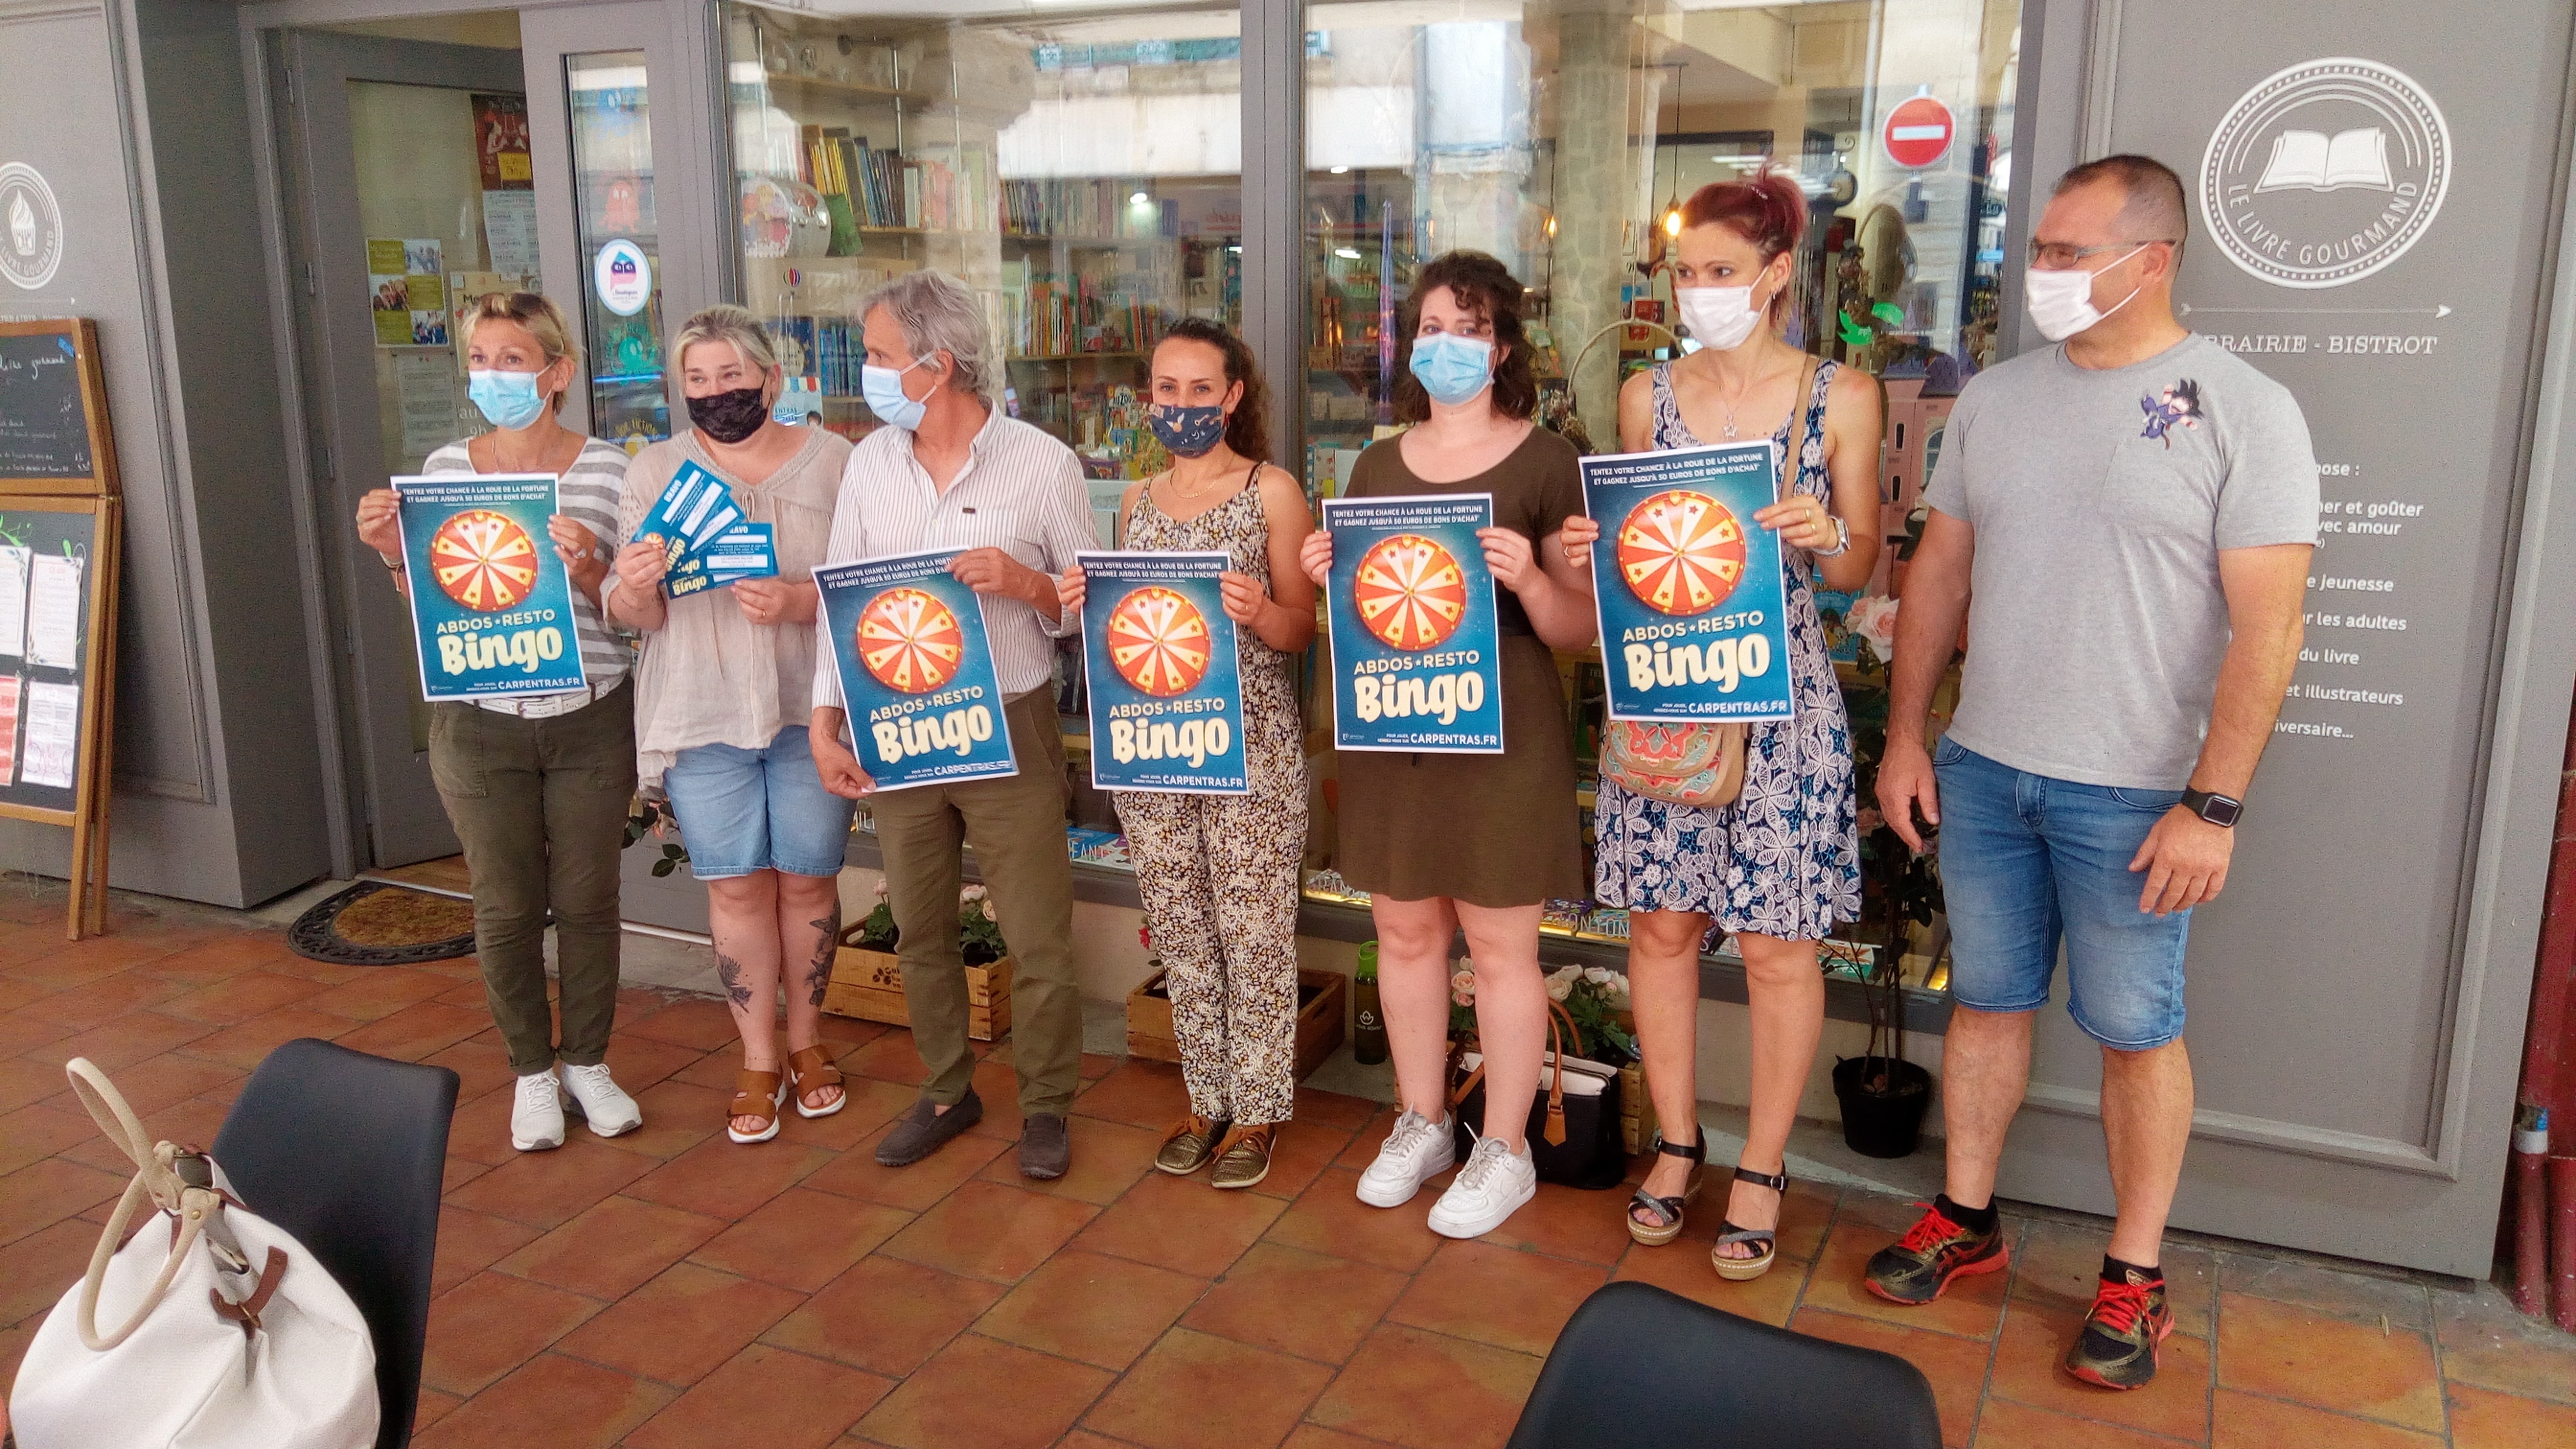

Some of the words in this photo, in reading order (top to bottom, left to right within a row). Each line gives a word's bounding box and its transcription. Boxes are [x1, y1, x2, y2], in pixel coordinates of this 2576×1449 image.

[2228, 184, 2250, 209] LE
[2299, 182, 2418, 265] GOURMAND
[2237, 211, 2291, 260] LIVRE
[2328, 335, 2439, 355] BISTROT
[1666, 461, 1672, 470] À
[1672, 462, 1682, 470] LA
[1706, 458, 1716, 466] DE
[1716, 457, 1728, 465] LA
[1594, 477, 1601, 486] ET
[1694, 470, 1704, 478] DE
[1401, 506, 1406, 516] À
[2345, 501, 2363, 515] et
[2367, 501, 2424, 519] goûter
[1335, 518, 1342, 526] ET
[1394, 517, 1401, 525] 50
[1423, 516, 1432, 525] DE
[2318, 521, 2342, 533] vec
[2347, 521, 2402, 535] amour
[934, 557, 953, 567] FORT
[672, 575, 707, 596] Bingo
[2319, 574, 2394, 592] jeunesse
[436, 616, 492, 635] ABDOS
[502, 608, 555, 627] RESTO
[1622, 621, 1687, 643] ABDOS
[1698, 610, 1765, 635] RESTO
[2317, 611, 2341, 626] les
[2346, 614, 2407, 631] adultes
[438, 626, 564, 675] Bingo
[2299, 647, 2319, 662] du
[2324, 648, 2360, 665] livre
[1354, 656, 1413, 675] ABDOS
[1423, 650, 1480, 669] RESTO
[1624, 633, 1771, 694] Bingo
[498, 677, 580, 690] CARPENTRAS.FR
[869, 697, 925, 723] ABDOS
[933, 684, 984, 707] RESTO
[1354, 670, 1485, 725] Bingo
[2285, 684, 2301, 697] et
[2305, 684, 2404, 705] illustrateurs
[1109, 702, 1164, 719] ABDOS
[1173, 697, 1226, 714] RESTO
[1689, 700, 1787, 714] CARPENTRAS.FR
[871, 704, 994, 764] Bingo
[2275, 719, 2354, 738] iversaire...
[1109, 717, 1230, 769] Bingo
[1411, 733, 1497, 745] CARPENTRAS.FR
[1163, 774, 1243, 788] CARPENTRAS.FR
